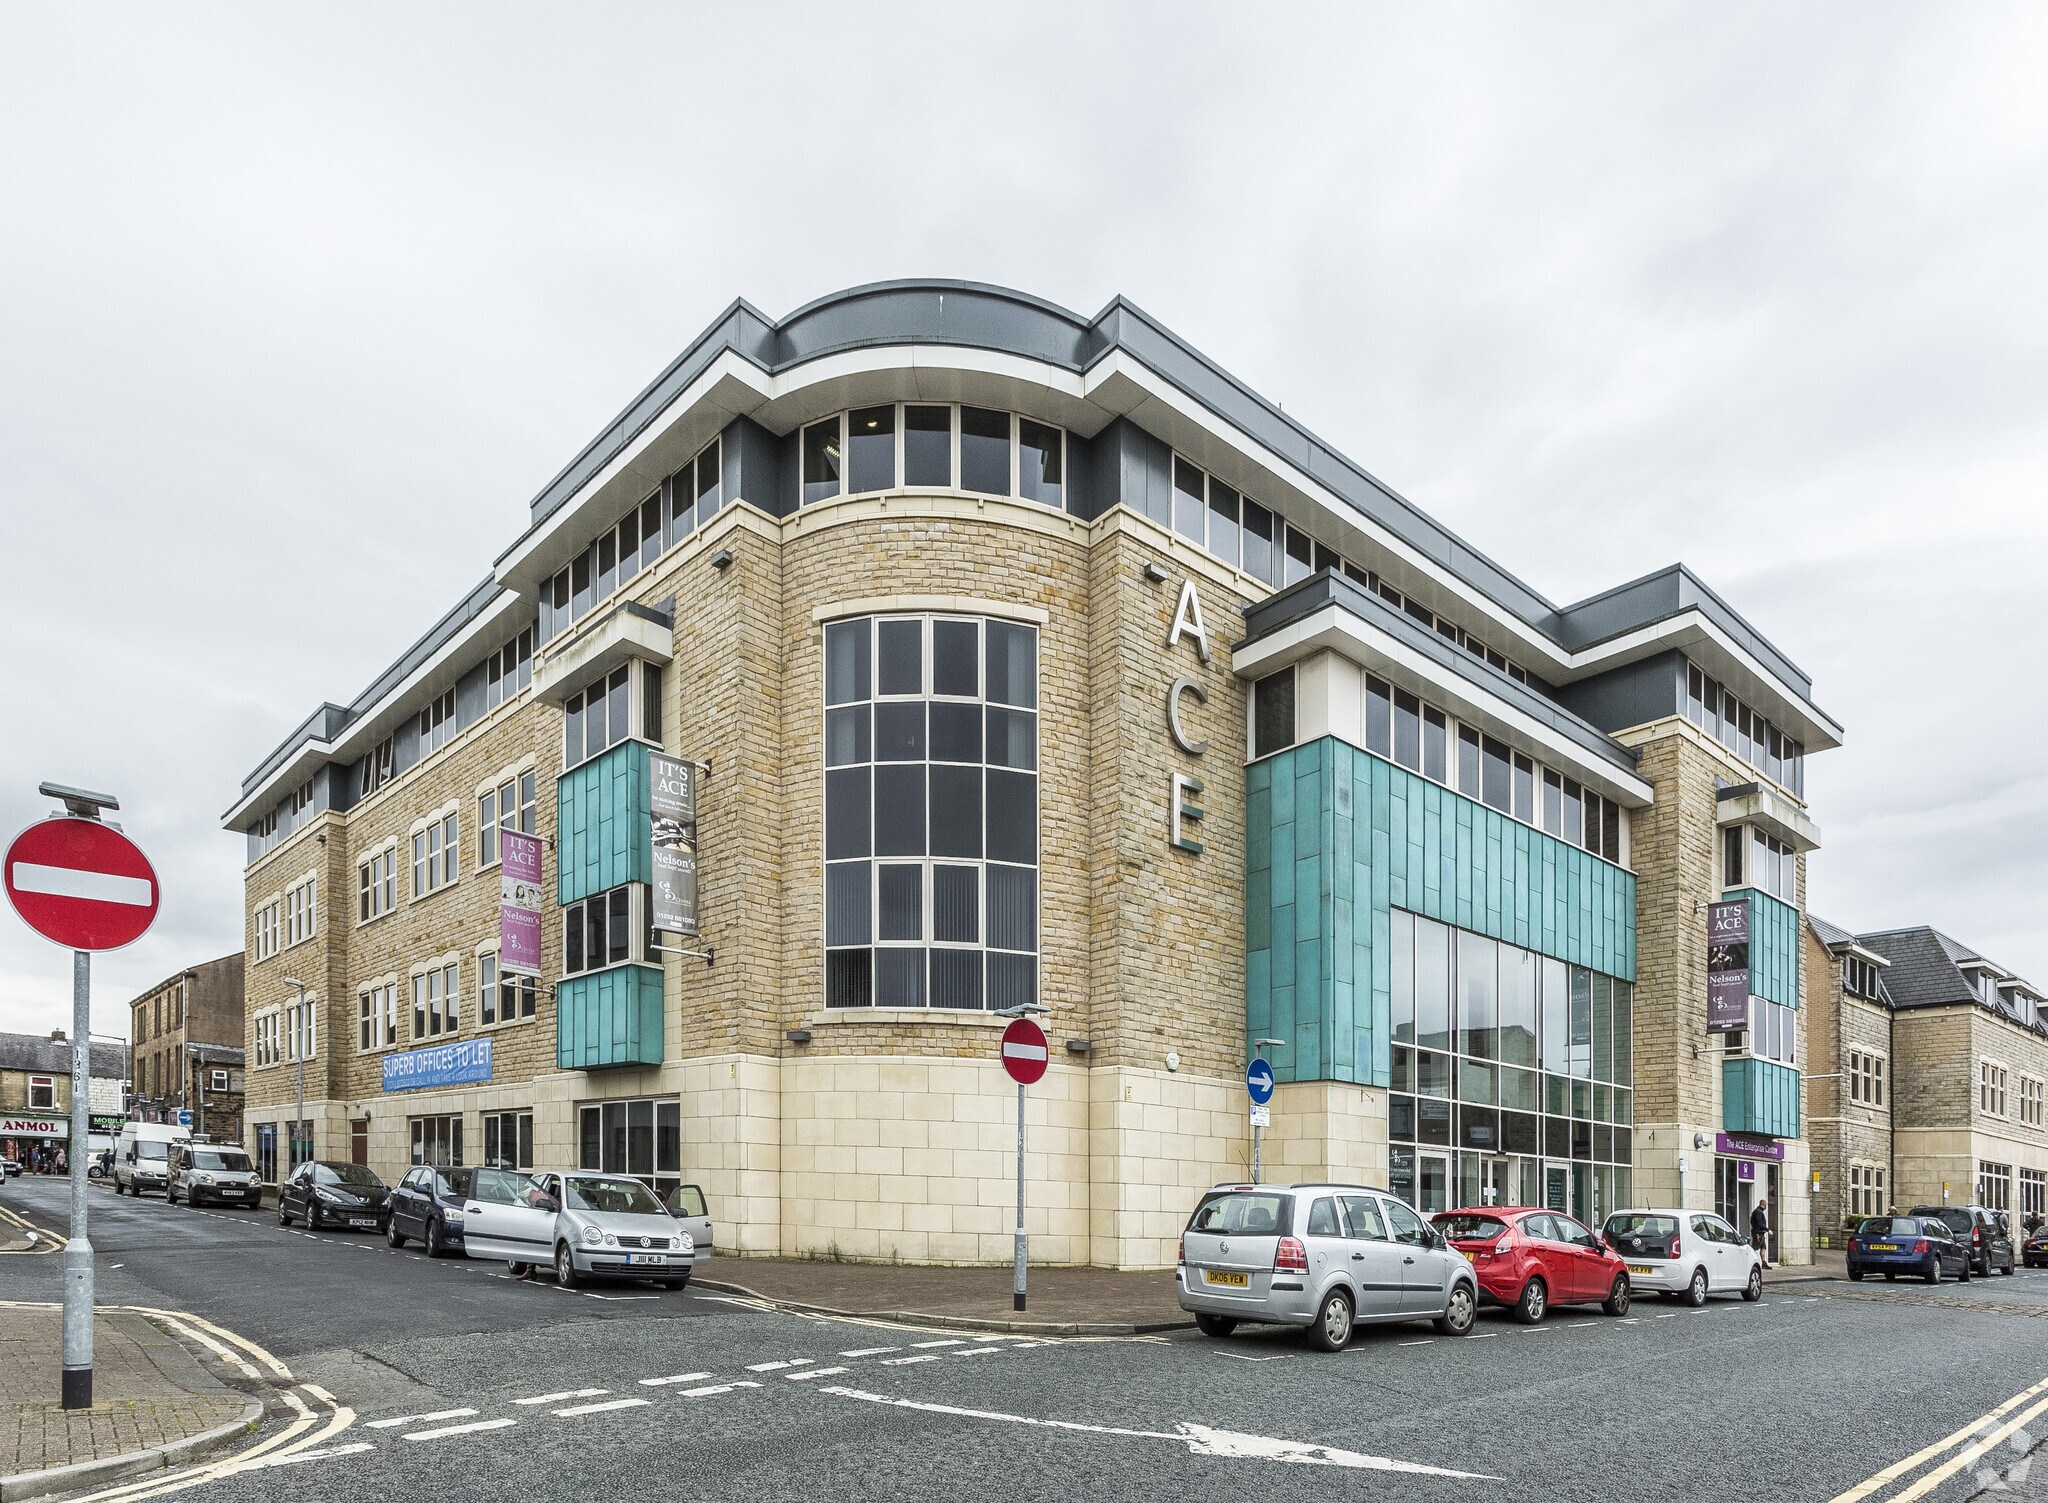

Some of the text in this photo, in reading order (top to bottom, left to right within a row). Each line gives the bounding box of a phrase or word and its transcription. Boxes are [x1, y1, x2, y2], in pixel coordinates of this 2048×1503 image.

[1167, 578, 1211, 854] ACE
[658, 760, 688, 780] IT'S
[658, 777, 688, 798] ACE
[509, 836, 535, 853] IT'S
[509, 850, 535, 866] ACE
[653, 852, 696, 870] Nelson's
[503, 909, 540, 925] Nelson's
[1715, 905, 1742, 919] IT'S
[1714, 918, 1742, 931] ACE
[1709, 974, 1747, 985] Nelson's
[383, 1042, 491, 1078] SUPERB OFFICES TO LET
[2, 1121, 58, 1133] ANMOL
[1726, 1139, 1778, 1154] The ACE Enterprise Centre
[1210, 1272, 1228, 1282] DK06
